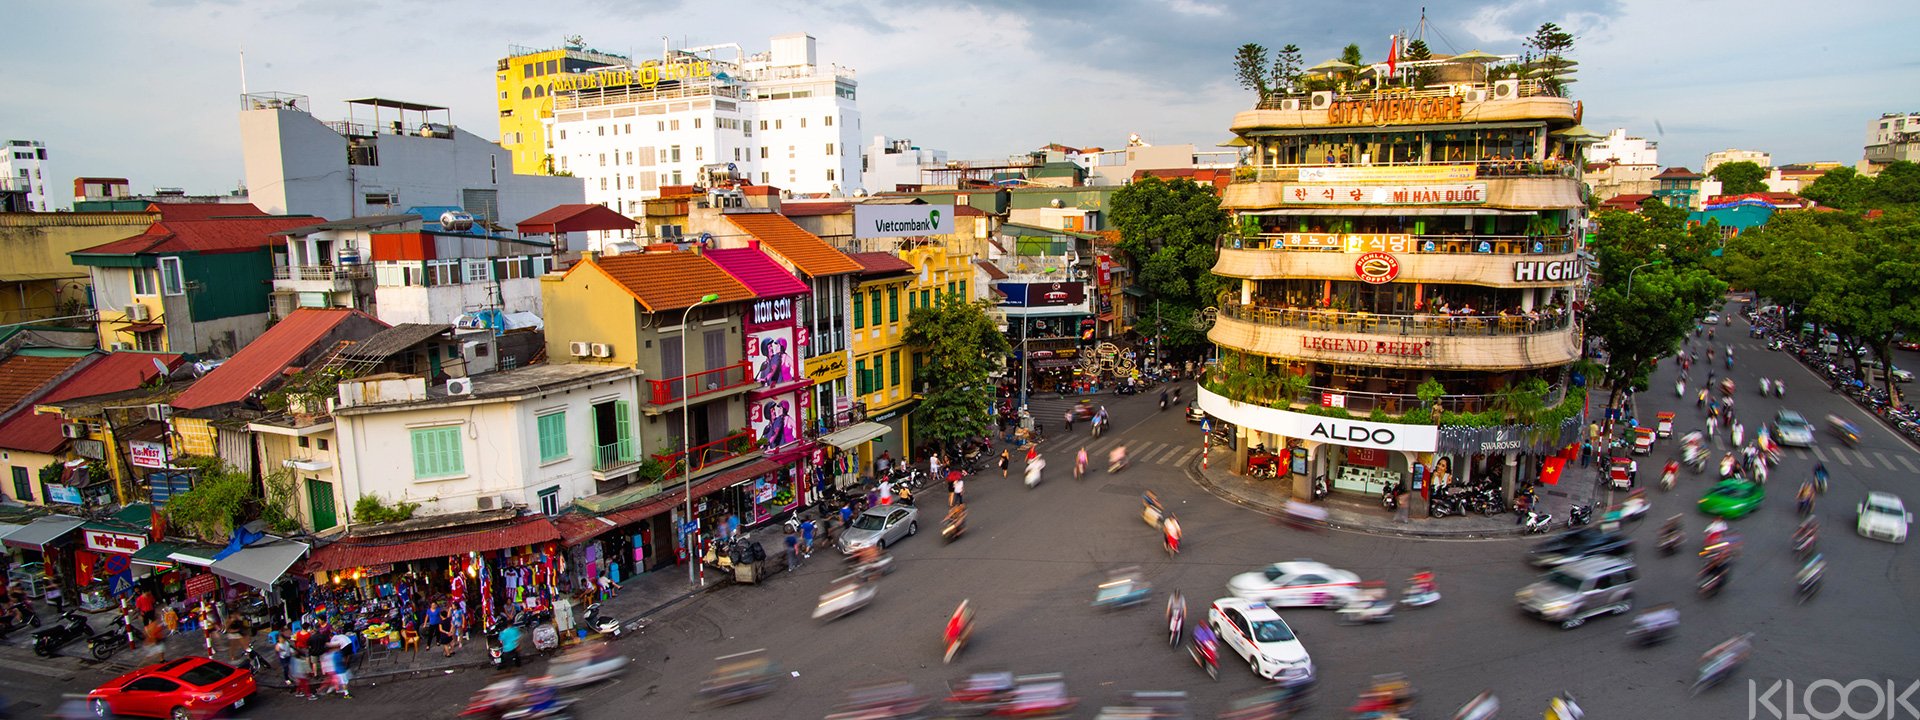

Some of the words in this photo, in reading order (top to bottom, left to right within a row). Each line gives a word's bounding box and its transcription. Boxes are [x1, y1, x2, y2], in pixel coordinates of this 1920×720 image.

[553, 77, 577, 91] MAY
[580, 74, 596, 89] DE
[599, 70, 632, 87] VILLE
[665, 61, 711, 80] HOTEL
[1328, 101, 1366, 123] CITY
[1371, 97, 1415, 121] VIEW
[1418, 96, 1462, 120] CAFE
[1393, 188, 1408, 202] MÌ
[1413, 187, 1440, 202] HÀN
[1445, 185, 1480, 201] QUỐC
[875, 218, 930, 232] Vietcombank
[1348, 235, 1406, 252] 한식당
[1357, 253, 1397, 267] HIGHLANDS
[1361, 273, 1391, 282] COFFEE
[754, 299, 773, 324] NÓN
[774, 297, 791, 320] SƠN
[1303, 336, 1368, 353] LEGEND
[1375, 341, 1423, 356] BEER
[1310, 422, 1395, 444] ALDO
[1480, 440, 1520, 450] SWAROVSKI
